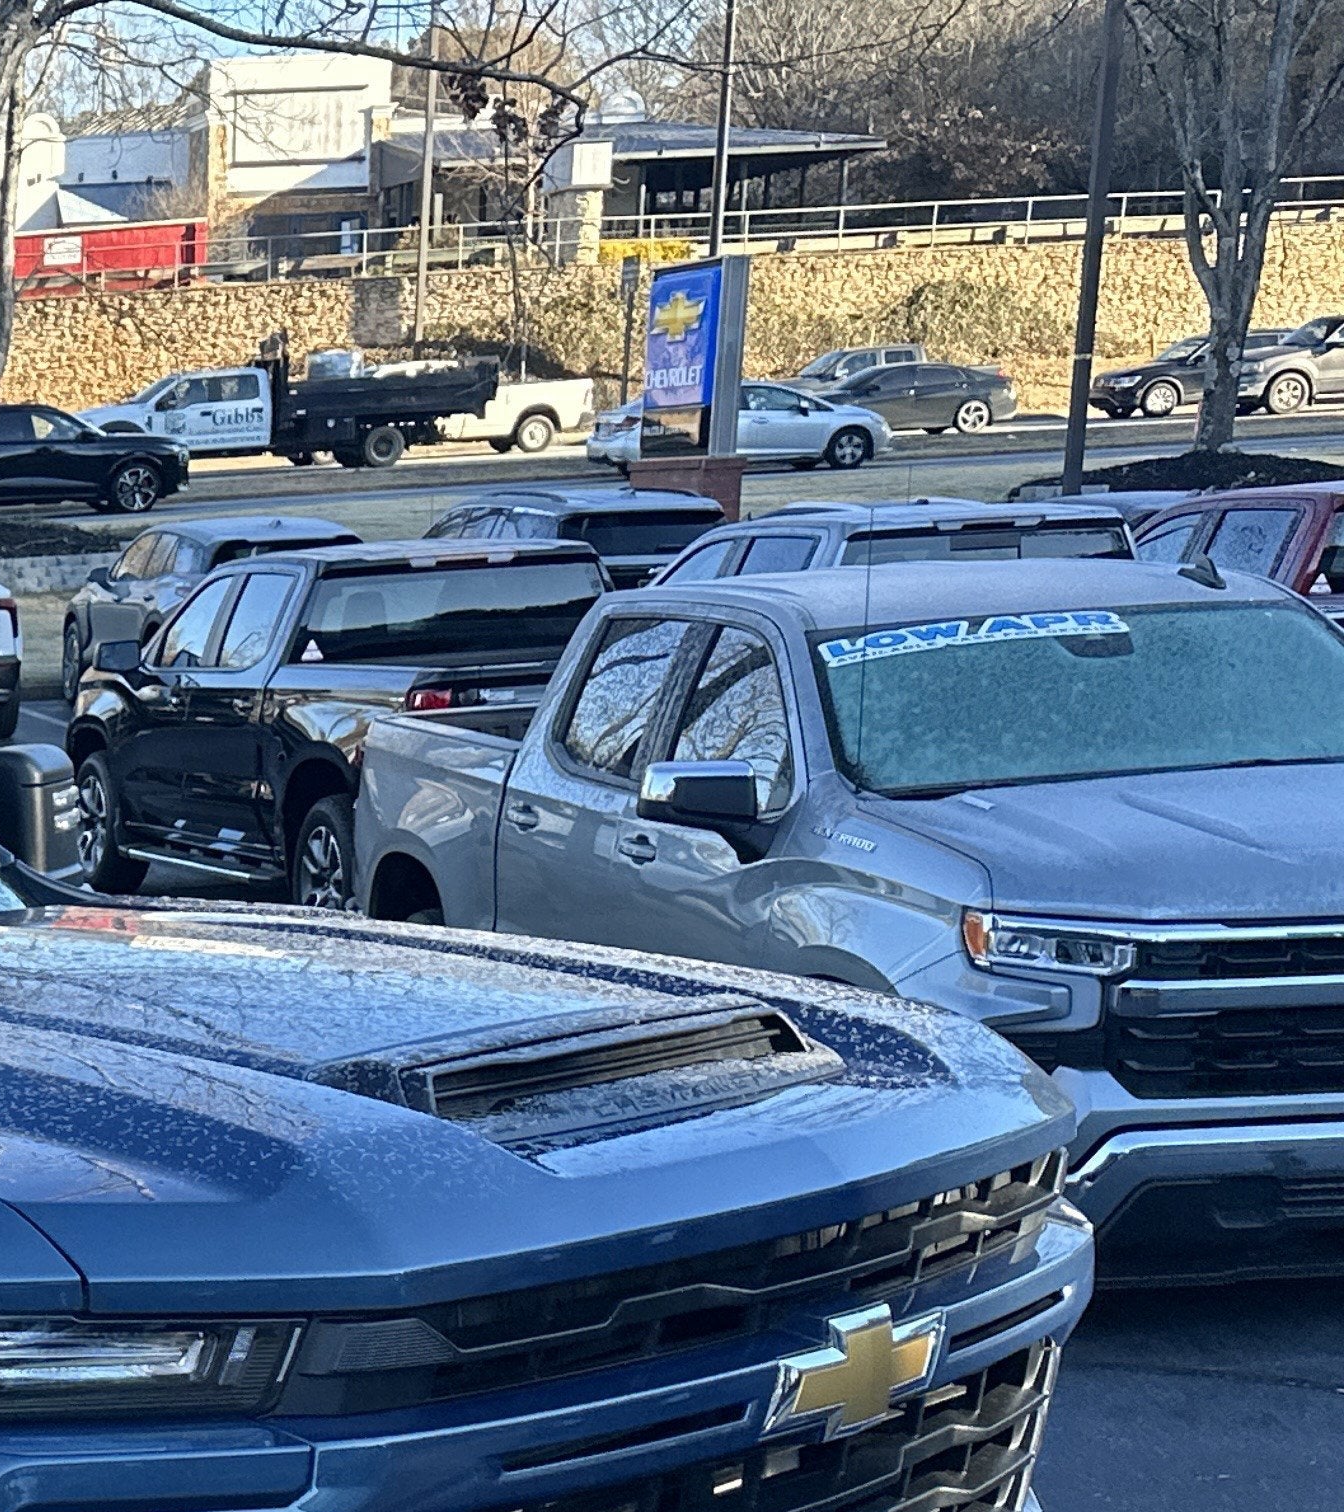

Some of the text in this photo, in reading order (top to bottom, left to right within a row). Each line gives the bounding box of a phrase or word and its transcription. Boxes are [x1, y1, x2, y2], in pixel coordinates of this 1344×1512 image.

[644, 365, 703, 389] CHEVROLET
[213, 407, 264, 426] Gibbs
[826, 613, 1114, 657] LOW APR
[836, 642, 945, 663] AVAILABLE
